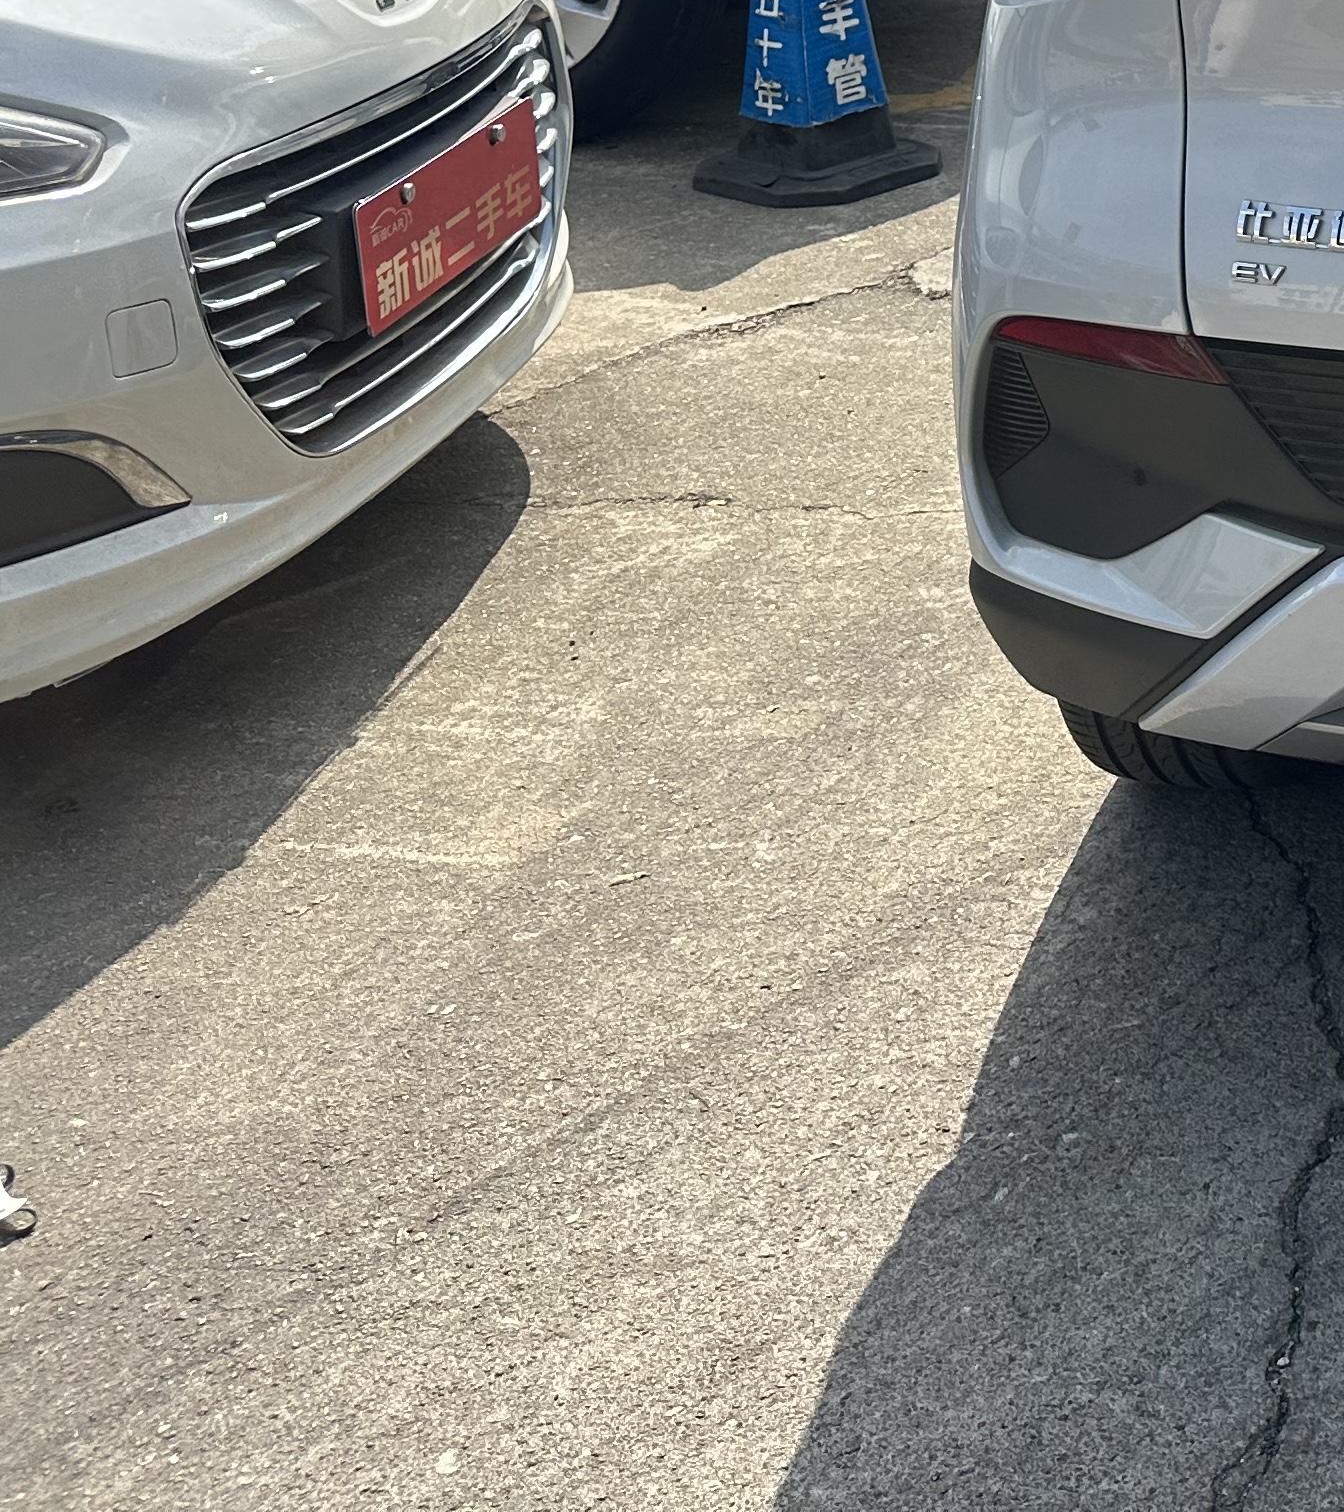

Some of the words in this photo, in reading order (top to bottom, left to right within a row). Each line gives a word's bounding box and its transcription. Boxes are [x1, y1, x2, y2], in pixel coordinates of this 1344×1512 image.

[375, 165, 533, 320] 新诚二手车
[1231, 261, 1286, 285] EV
